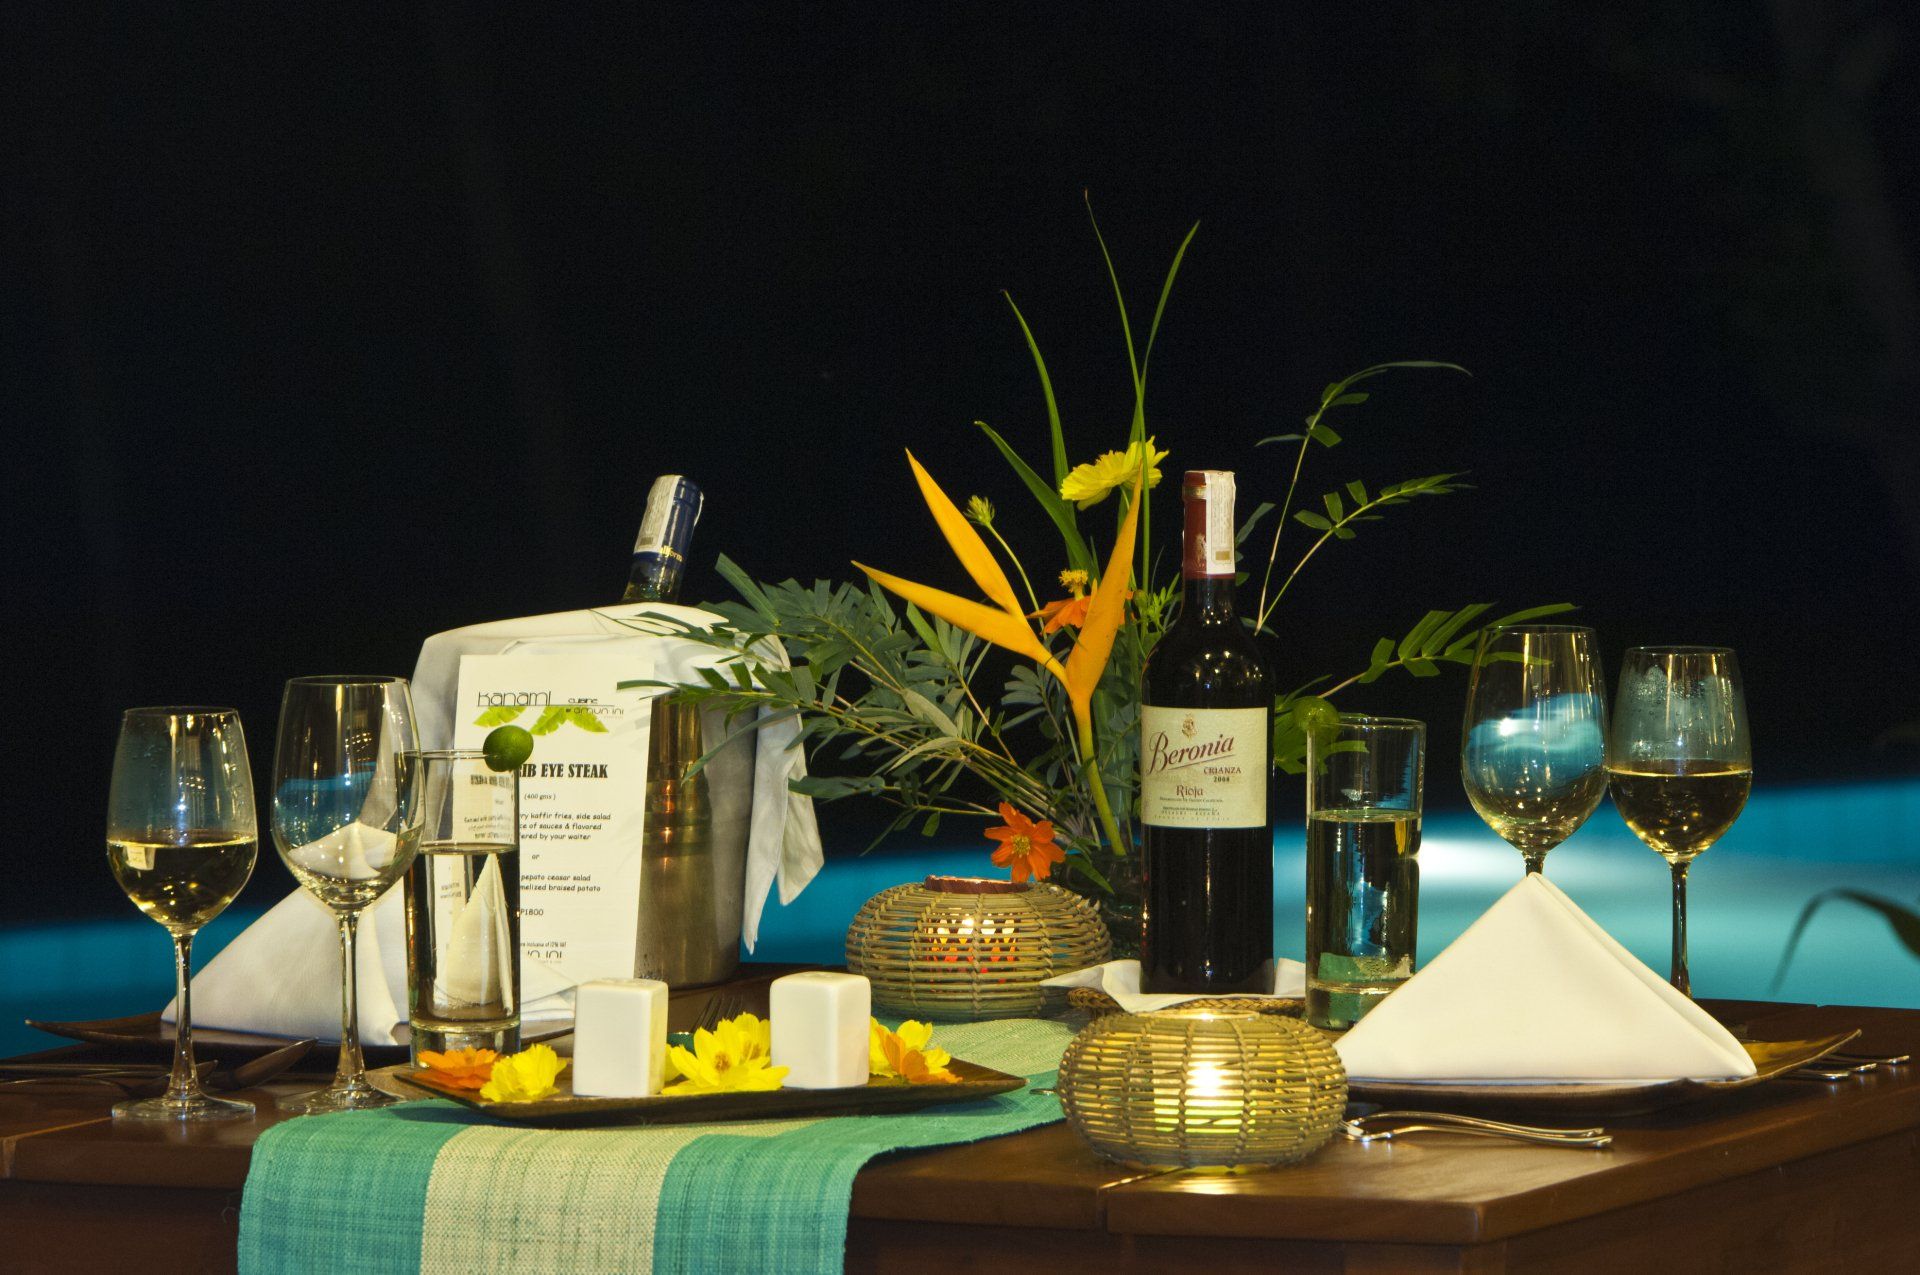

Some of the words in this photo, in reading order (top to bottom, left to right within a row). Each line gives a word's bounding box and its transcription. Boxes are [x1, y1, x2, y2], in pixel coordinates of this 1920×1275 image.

[1147, 731, 1235, 775] Beronia
[541, 763, 564, 778] EYE
[567, 763, 609, 779] STEAK
[1203, 766, 1242, 775] CRIANZA
[1176, 785, 1204, 799] Rioja
[576, 812, 591, 820] side
[592, 812, 611, 821] salad
[529, 822, 538, 830] of
[572, 823, 602, 831] flavored
[539, 833, 549, 841] by
[573, 874, 592, 882] salad
[548, 884, 576, 892] braised
[577, 885, 601, 893] potato
